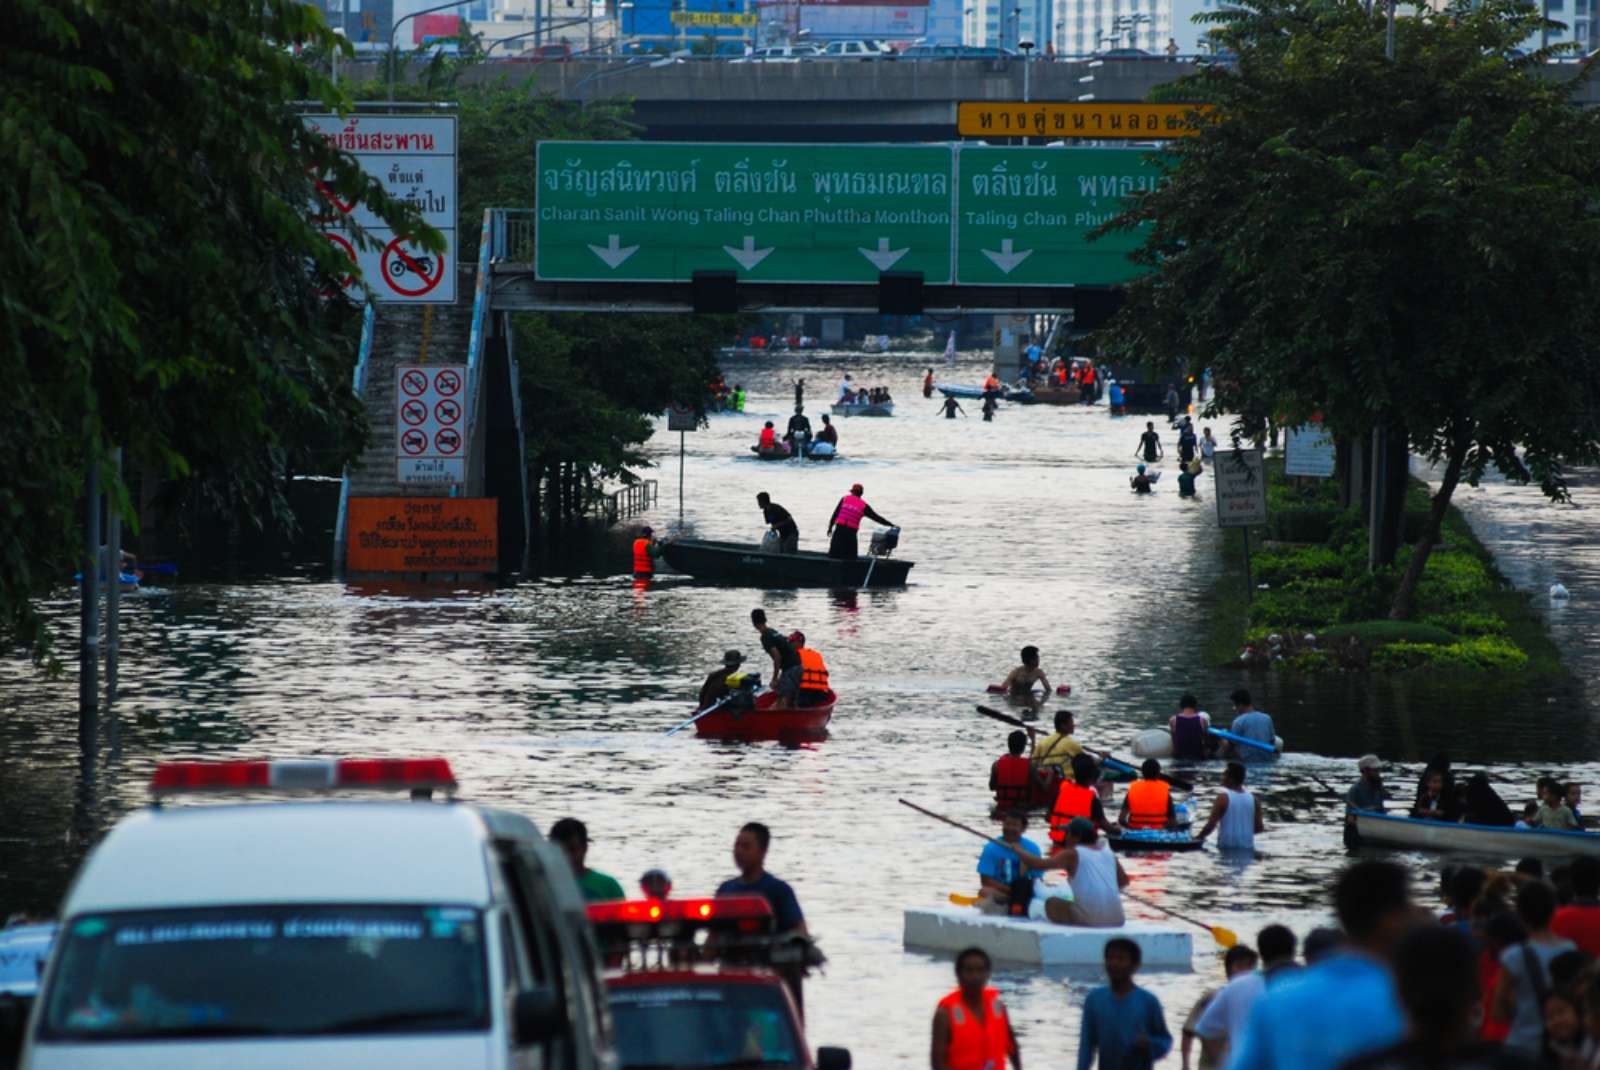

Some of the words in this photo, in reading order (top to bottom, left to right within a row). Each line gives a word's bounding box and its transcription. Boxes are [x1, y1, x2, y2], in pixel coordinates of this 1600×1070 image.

[388, 163, 424, 184] ตั้งแต่
[544, 158, 700, 196] จรัญสนิทวงศ์
[714, 158, 796, 193] ตลิ่งชัน
[812, 171, 947, 203] พุทธมณฑล
[972, 160, 1057, 197] ตลิ่งชัน
[541, 207, 600, 221] Charan
[603, 207, 646, 221] Sanit
[651, 208, 699, 224] Wong
[704, 208, 754, 226] Taling
[758, 208, 800, 223] Chan
[804, 208, 871, 223] Phuttha
[875, 209, 949, 224] Monthon
[966, 211, 1017, 229] Taling
[1023, 211, 1067, 226] Chan
